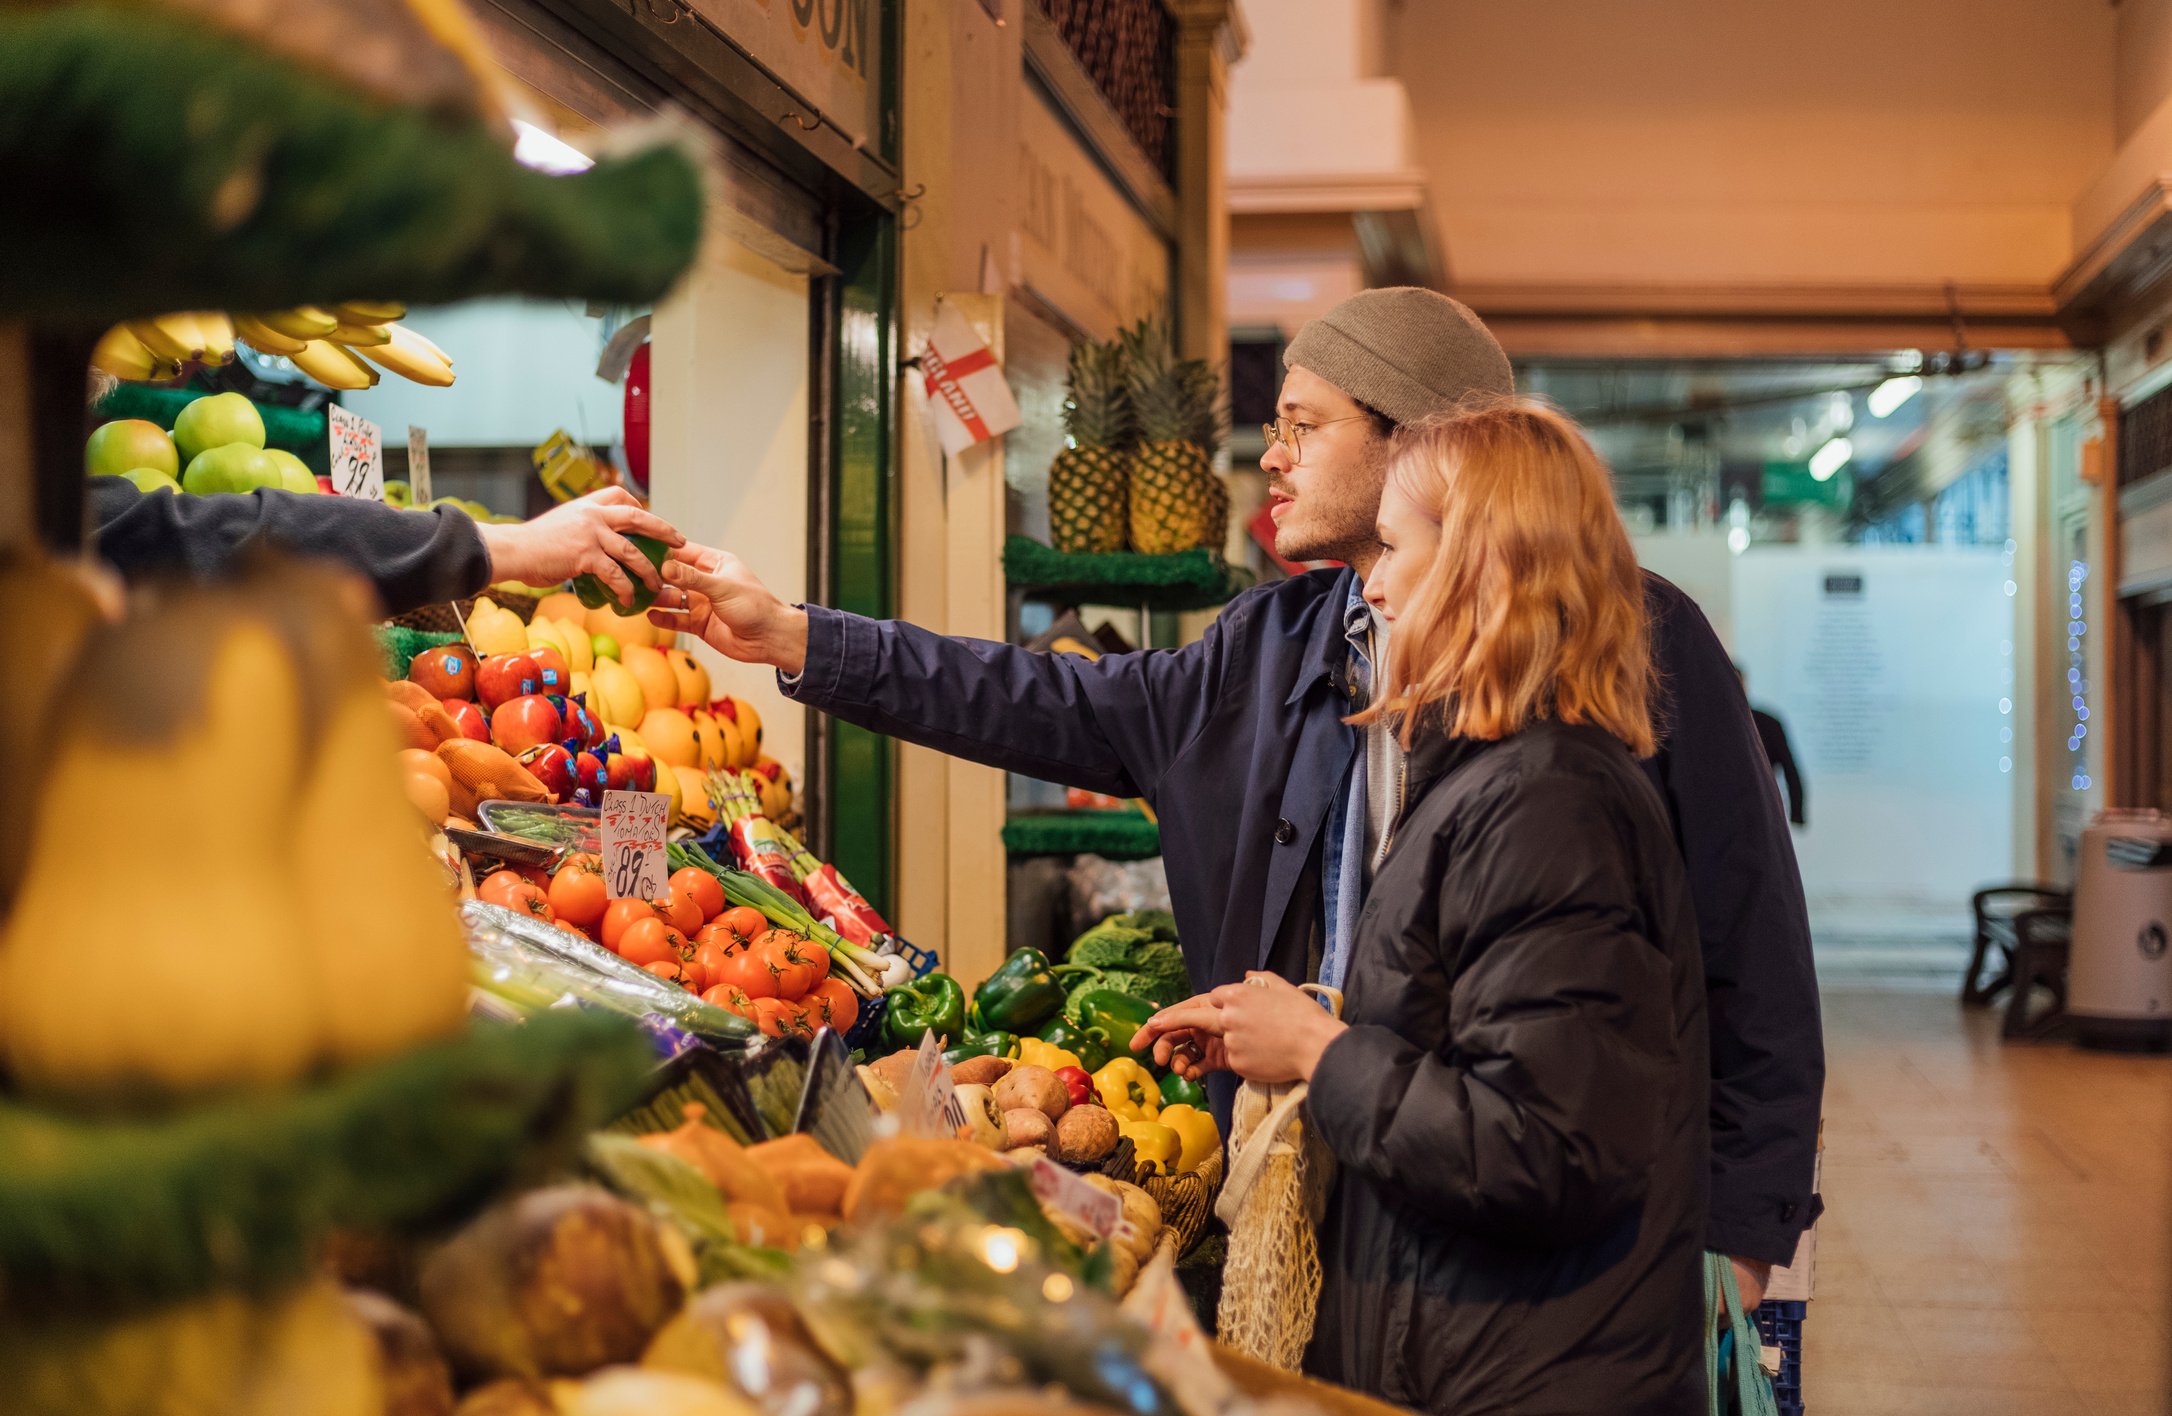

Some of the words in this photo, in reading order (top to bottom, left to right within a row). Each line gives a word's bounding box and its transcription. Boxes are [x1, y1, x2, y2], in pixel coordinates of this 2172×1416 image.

[629, 795, 637, 813] 1
[639, 795, 668, 816] DUTCH
[616, 845, 644, 897] 89
